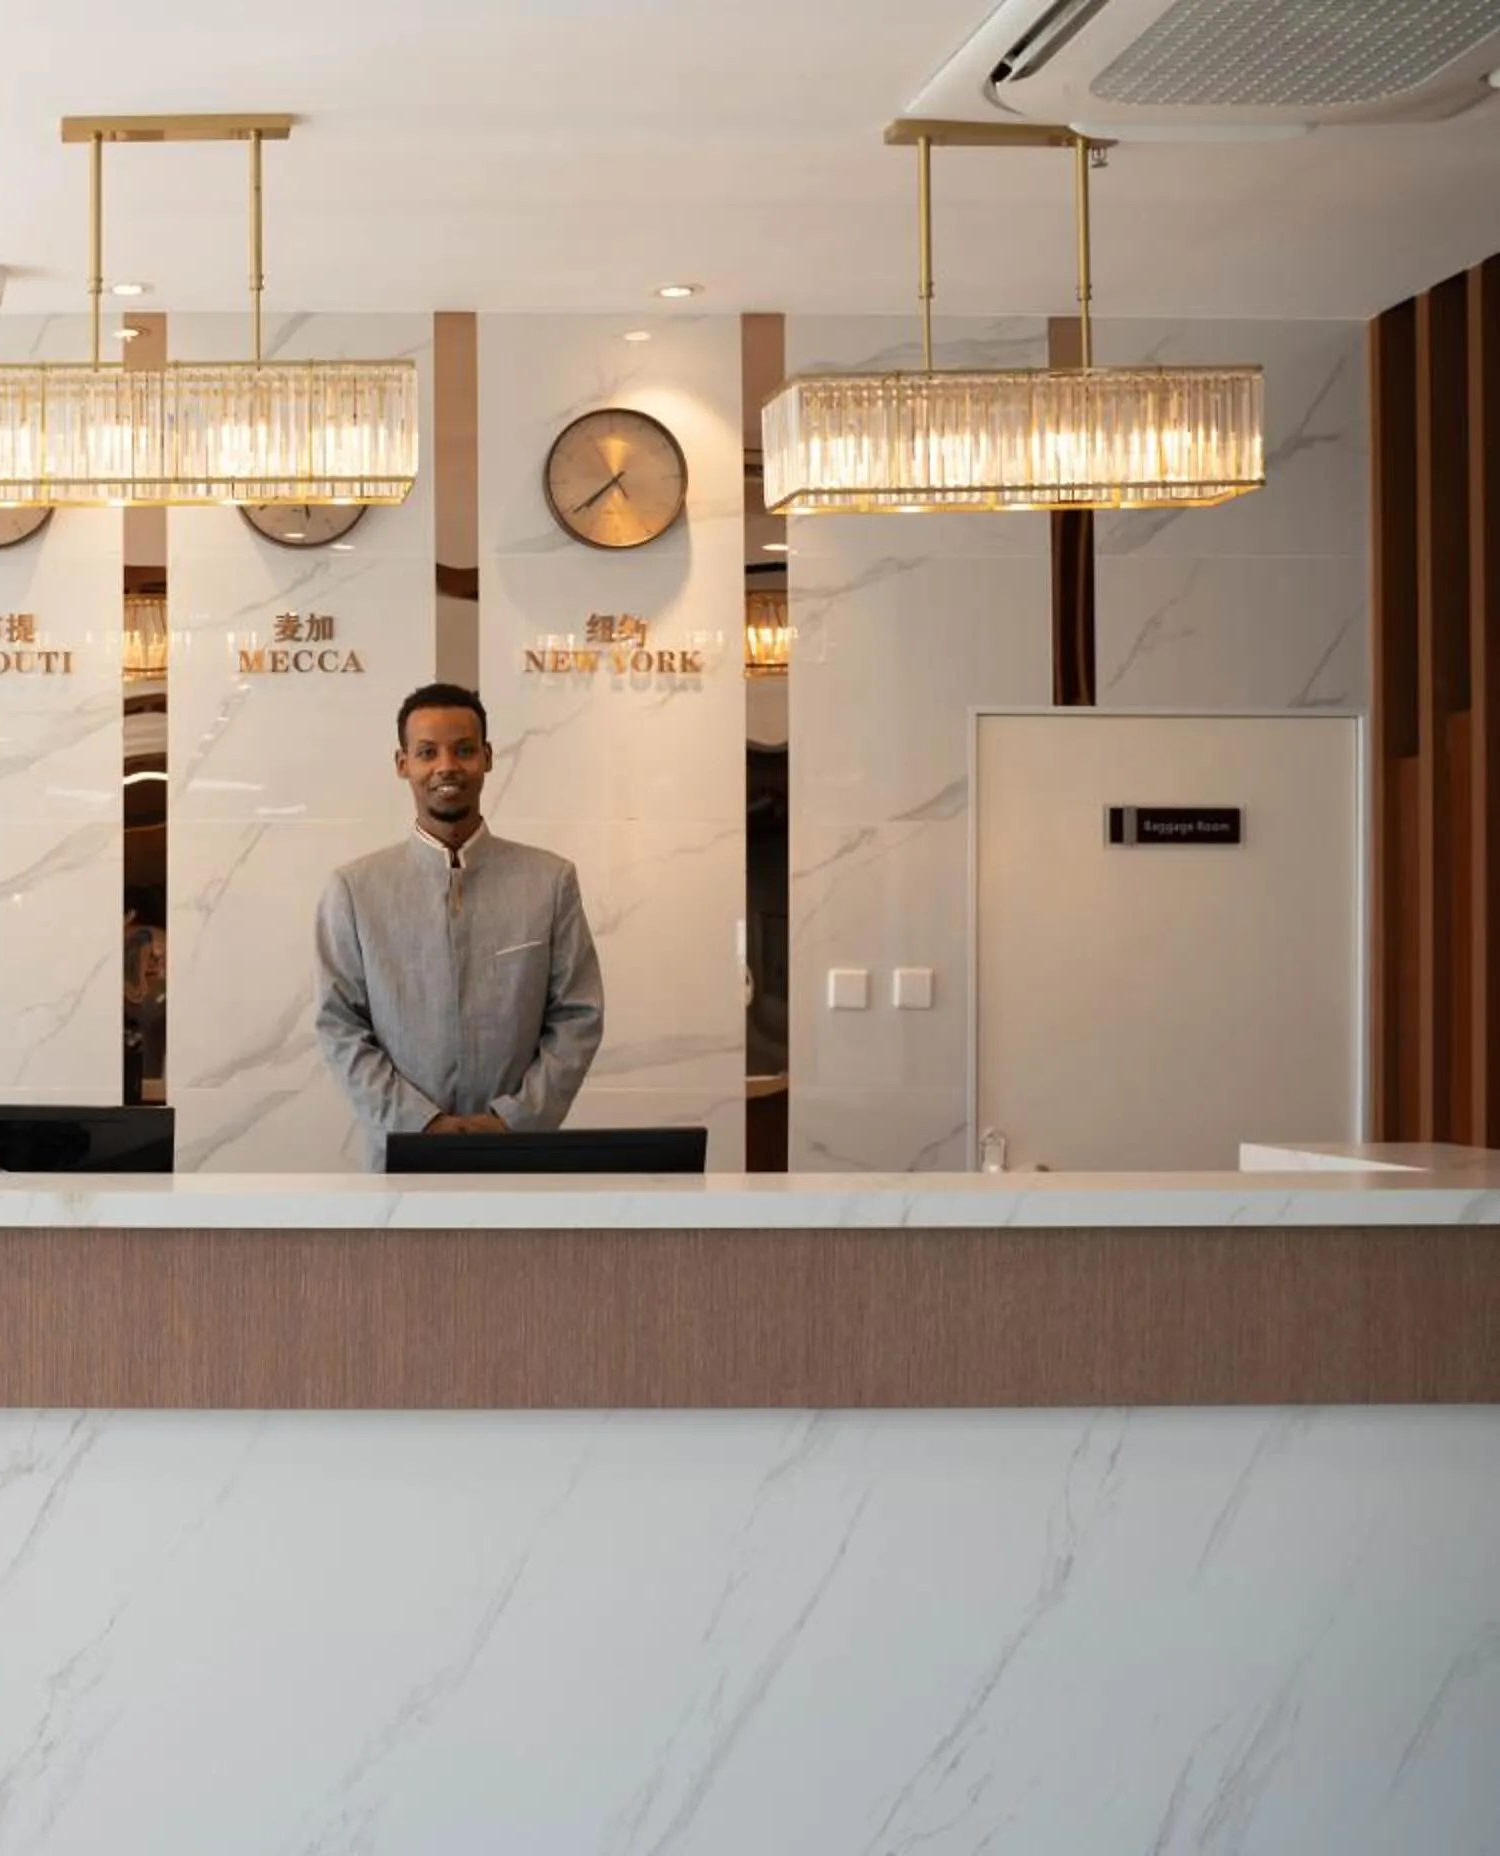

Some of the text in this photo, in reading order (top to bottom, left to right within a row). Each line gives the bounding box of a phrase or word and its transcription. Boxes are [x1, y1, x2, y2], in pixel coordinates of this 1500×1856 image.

[274, 612, 334, 643] 麦加
[585, 613, 648, 645] 纽约
[238, 649, 366, 674] MECCA
[524, 649, 704, 674] NEW YORK
[1197, 820, 1230, 833] Room
